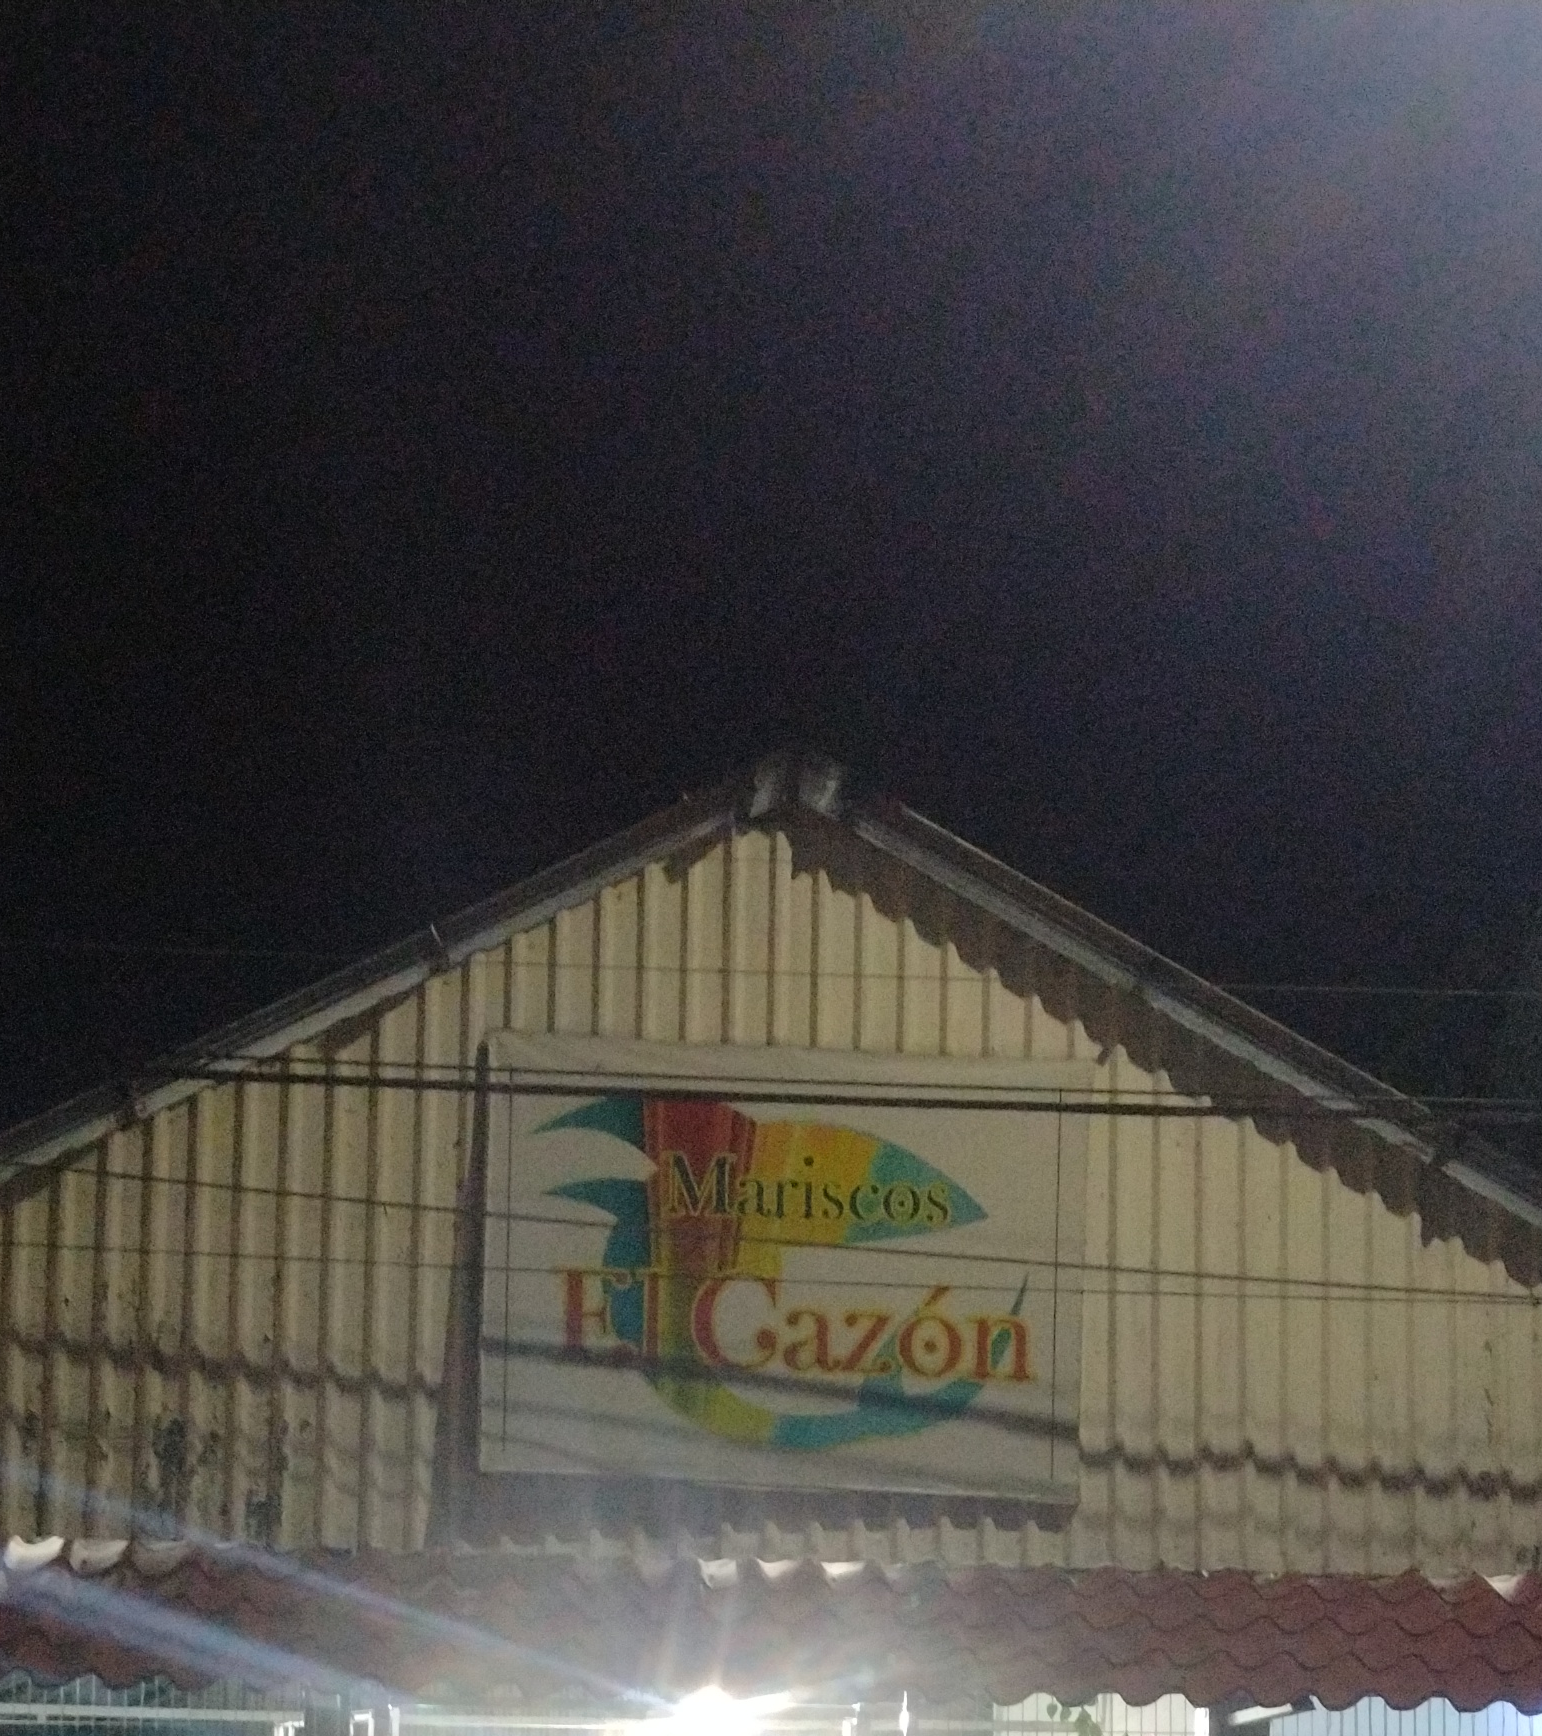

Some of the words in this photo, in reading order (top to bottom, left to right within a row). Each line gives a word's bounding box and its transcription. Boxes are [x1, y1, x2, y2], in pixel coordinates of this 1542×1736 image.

[663, 1151, 950, 1226] Mariscos
[557, 1267, 663, 1360] El
[691, 1277, 1036, 1383] Cazón
